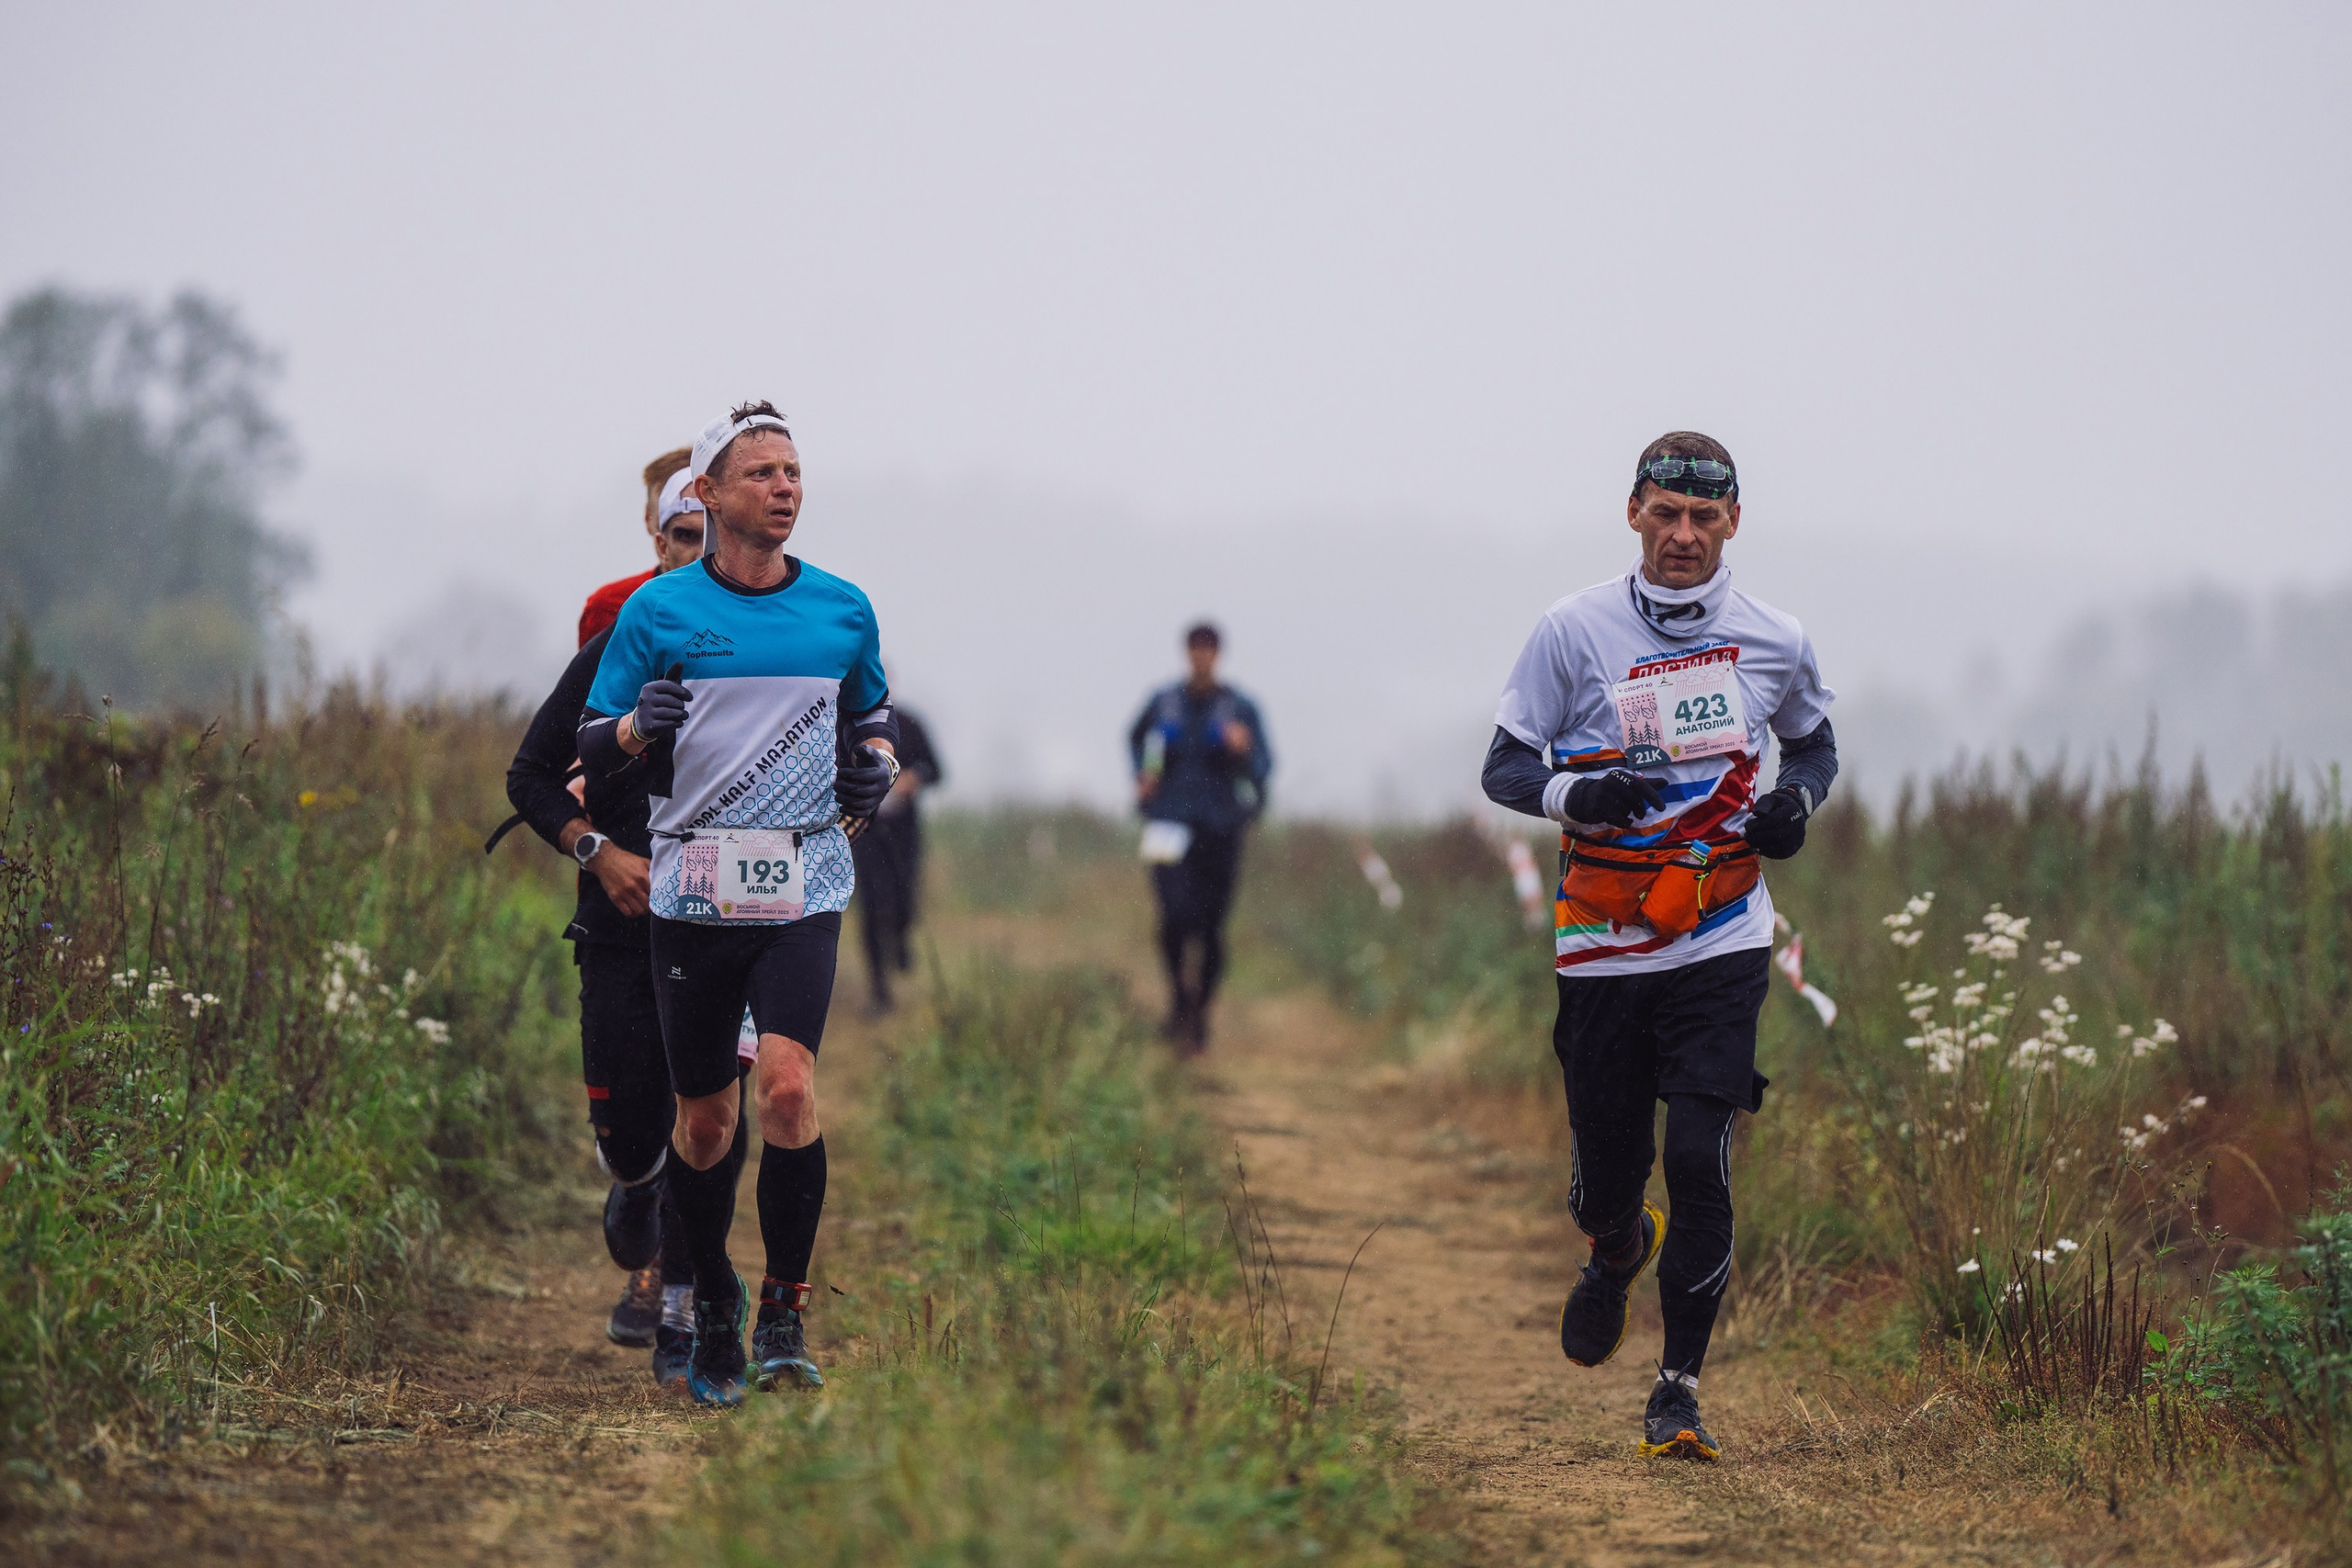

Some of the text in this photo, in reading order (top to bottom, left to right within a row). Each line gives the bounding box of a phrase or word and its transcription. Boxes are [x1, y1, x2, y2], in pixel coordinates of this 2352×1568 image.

[685, 649, 734, 659] TopResults
[1623, 684, 1645, 693] СПОРТ
[1674, 694, 1729, 723] 423
[1675, 716, 1735, 736] АНАТОЛИЙ
[718, 770, 756, 807] HALF
[755, 696, 828, 774] MARATHON
[1684, 740, 1708, 750] ВОСЬМОЙ
[1685, 746, 1709, 754] АТОМНЫЙ
[1635, 749, 1662, 764] 21K
[737, 860, 789, 884] 193
[747, 886, 777, 894] ИЛЬЯ
[685, 902, 712, 915] 21K
